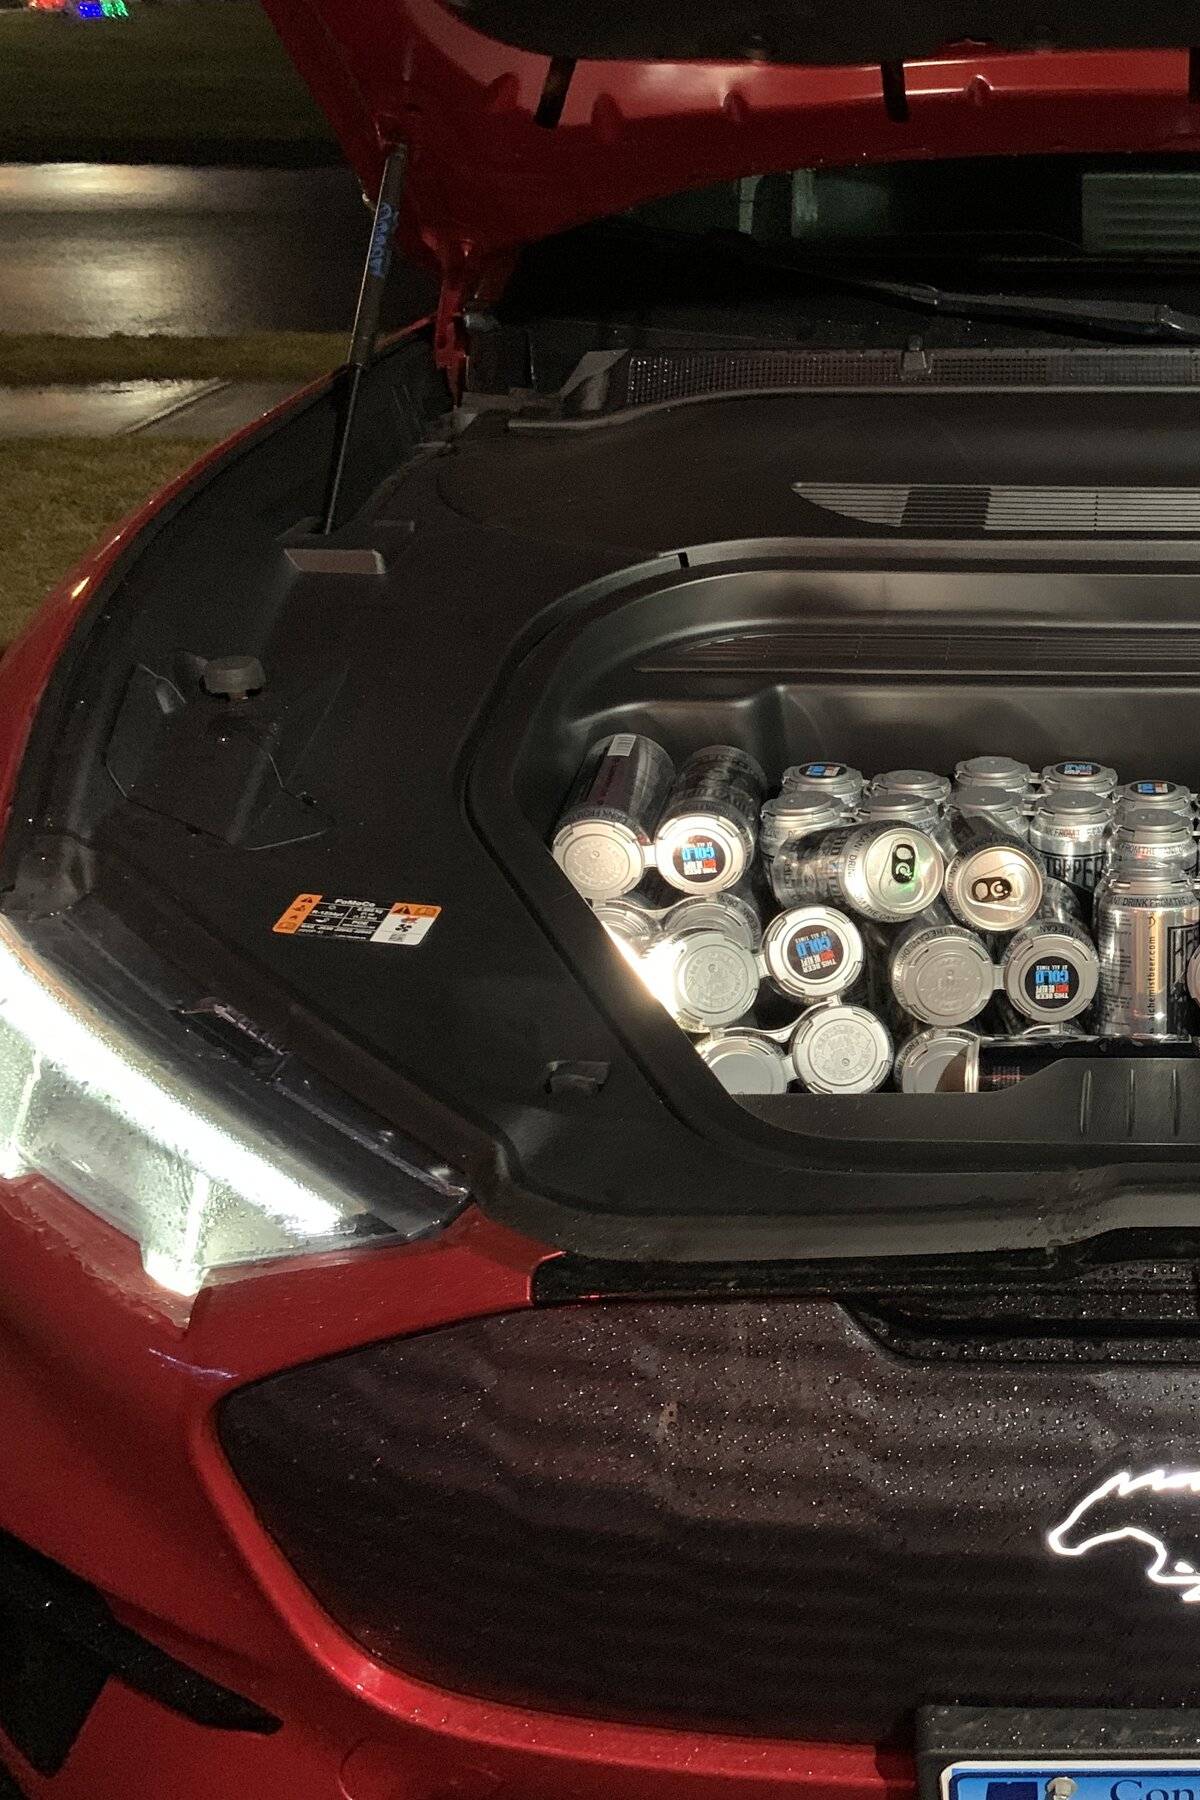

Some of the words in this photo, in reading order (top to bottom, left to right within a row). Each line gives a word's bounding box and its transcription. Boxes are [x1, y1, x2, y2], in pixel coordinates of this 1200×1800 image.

[682, 846, 716, 861] COLD
[1122, 897, 1147, 908] DRINK
[795, 936, 833, 958] COLD
[1035, 970, 1069, 984] COLD
